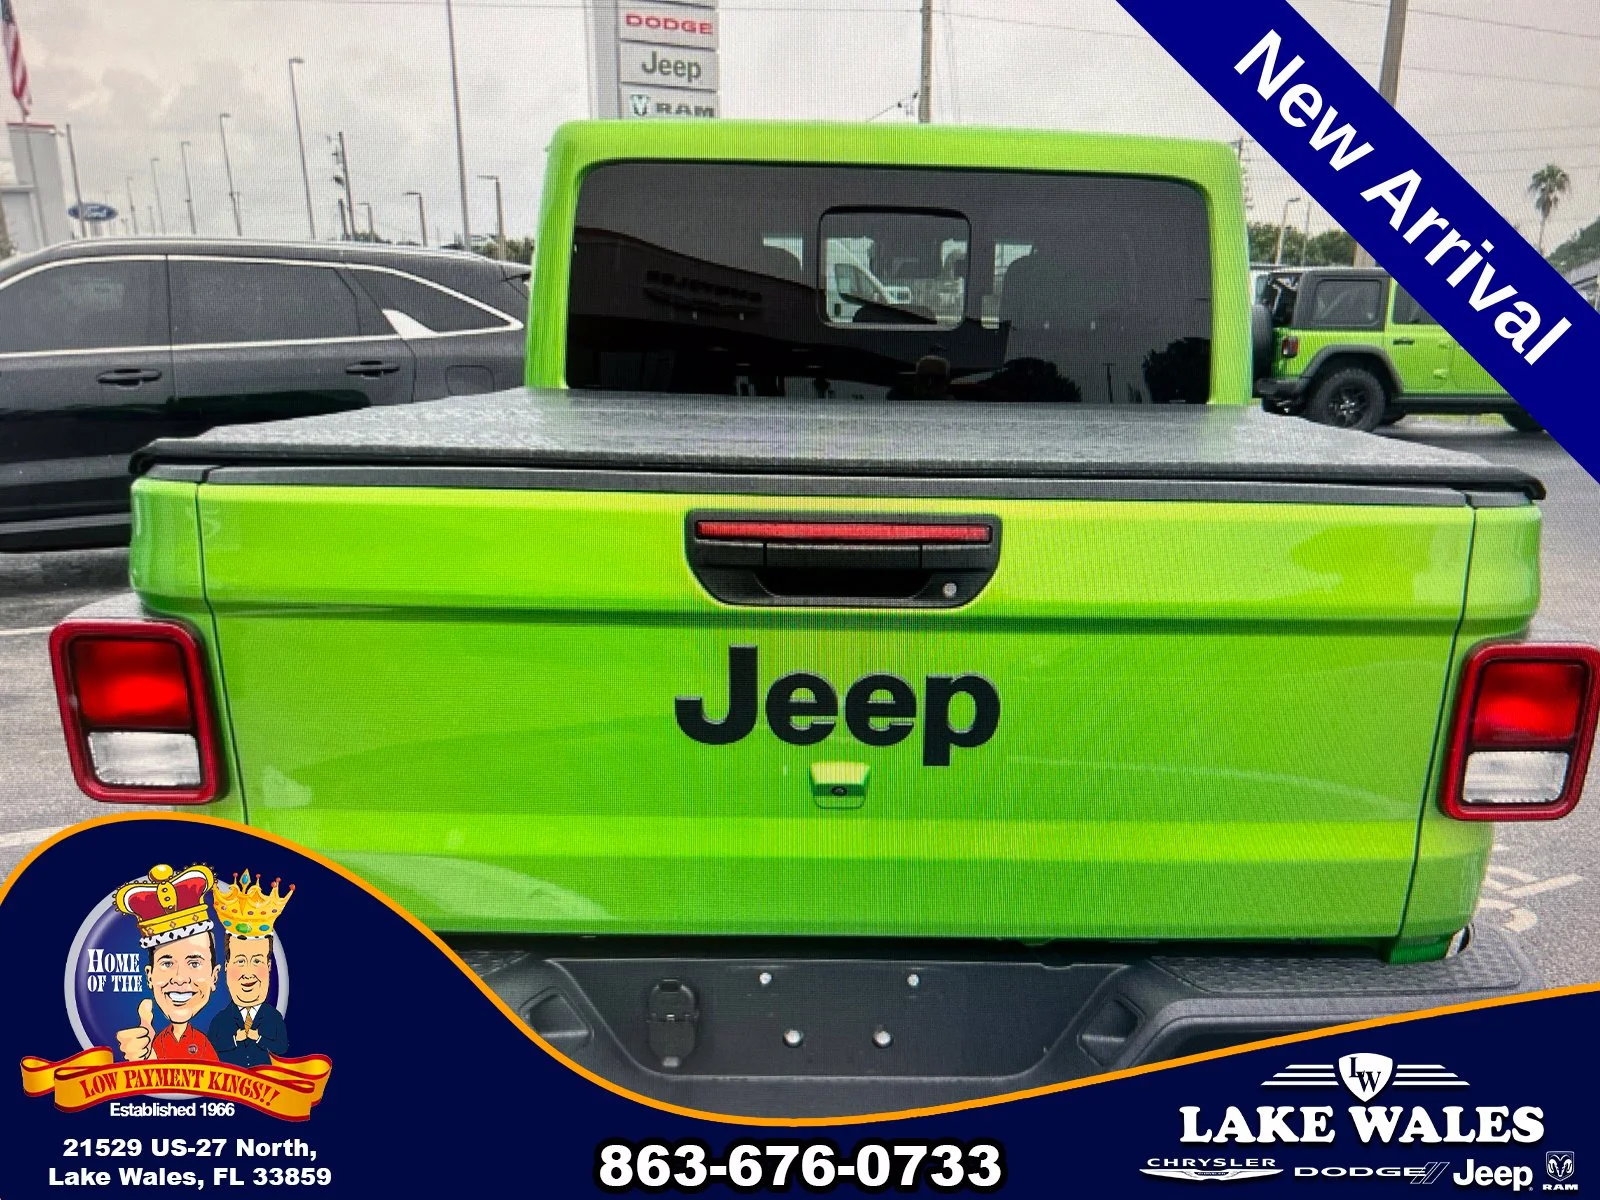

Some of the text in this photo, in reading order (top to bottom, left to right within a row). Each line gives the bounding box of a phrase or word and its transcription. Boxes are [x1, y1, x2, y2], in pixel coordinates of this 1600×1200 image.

[625, 14, 713, 35] DODGE
[641, 50, 702, 83] Jeep
[656, 102, 715, 118] RAM
[673, 643, 1002, 767] Jeep
